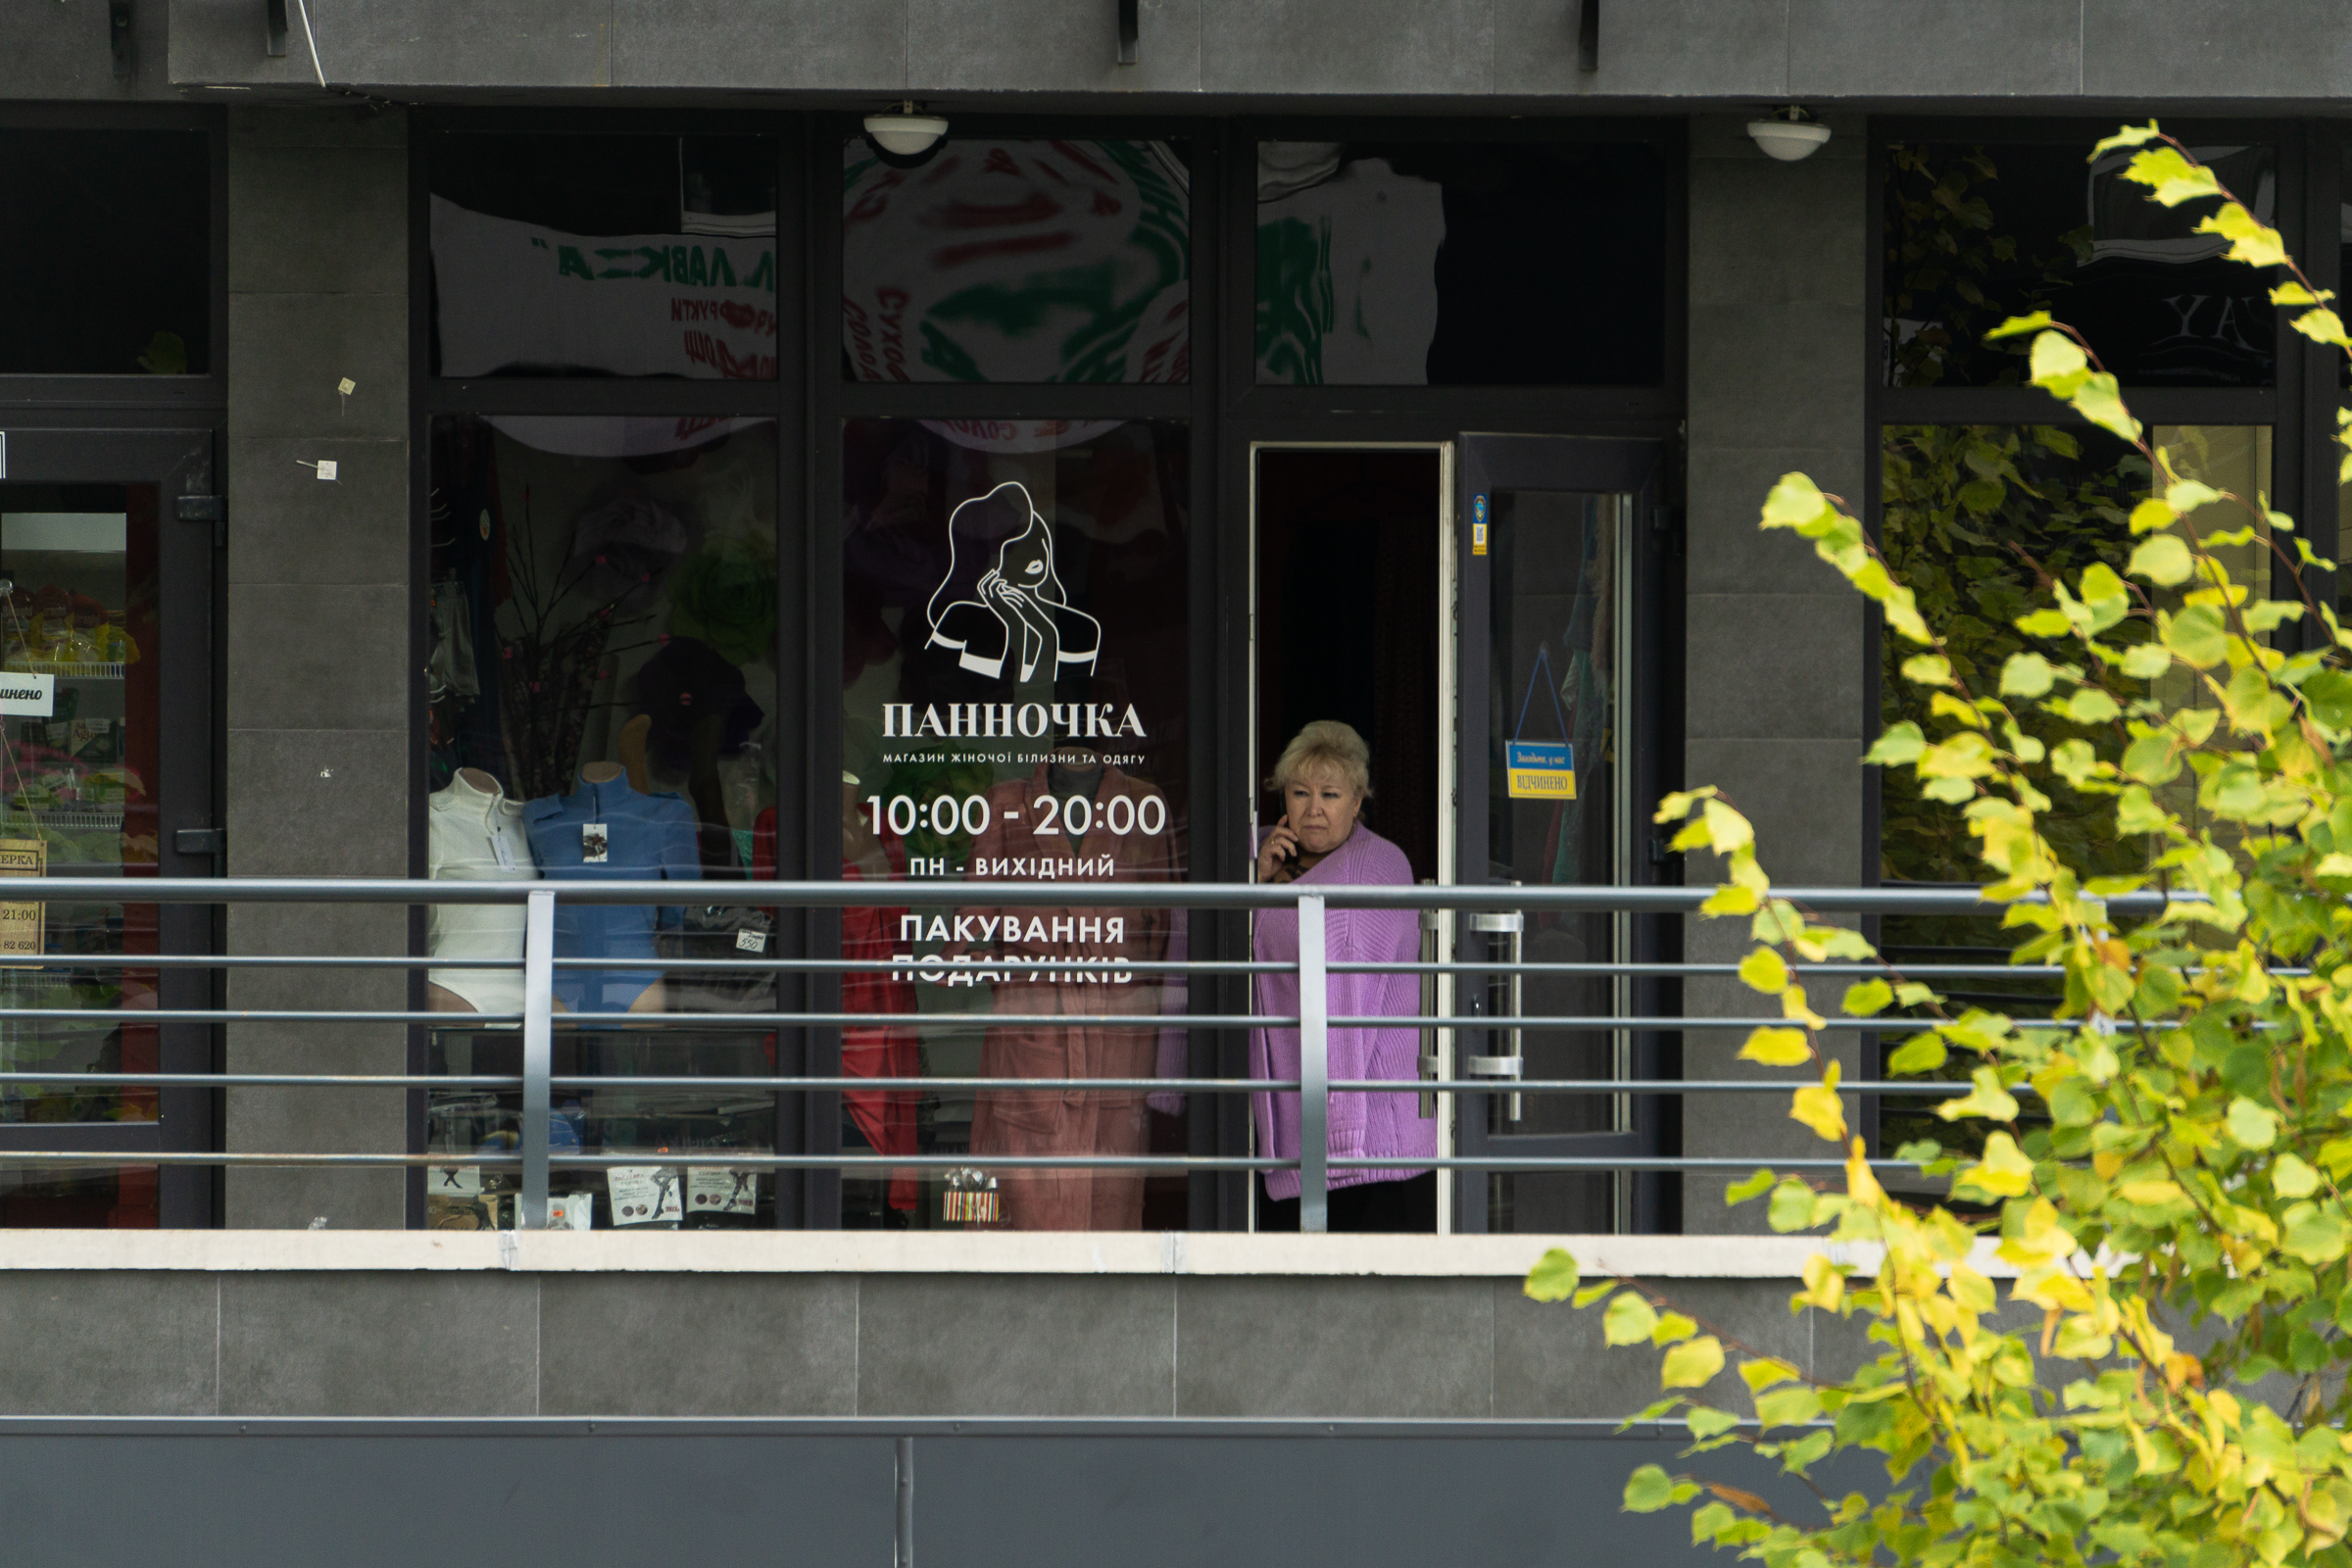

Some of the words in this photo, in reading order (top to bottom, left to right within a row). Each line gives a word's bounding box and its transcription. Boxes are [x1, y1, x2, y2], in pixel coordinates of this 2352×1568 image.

[882, 703, 1148, 738] ПАННОЧКА
[883, 753, 945, 763] МАГАЗИН
[951, 752, 1011, 763] ЖІНОЧОЇ
[1017, 753, 1076, 764] БІЛИЗНИ
[1082, 754, 1097, 764] ТА
[1102, 754, 1147, 766] ОДЯГУ
[1517, 774, 1568, 792] ВІДЧИНЕНО
[866, 795, 991, 835] 10:00
[1004, 810, 1019, 819] -
[1032, 795, 1166, 835] 20:00
[909, 858, 945, 876] ПН
[975, 854, 1115, 879] ВИХІДНИЙ
[2, 908, 36, 921] 21:00
[900, 914, 1125, 944] ПАКУВАННЯ
[3, 941, 16, 950] 82
[18, 942, 36, 951] 620
[892, 955, 1133, 987] ПОДАРУНКІВ
